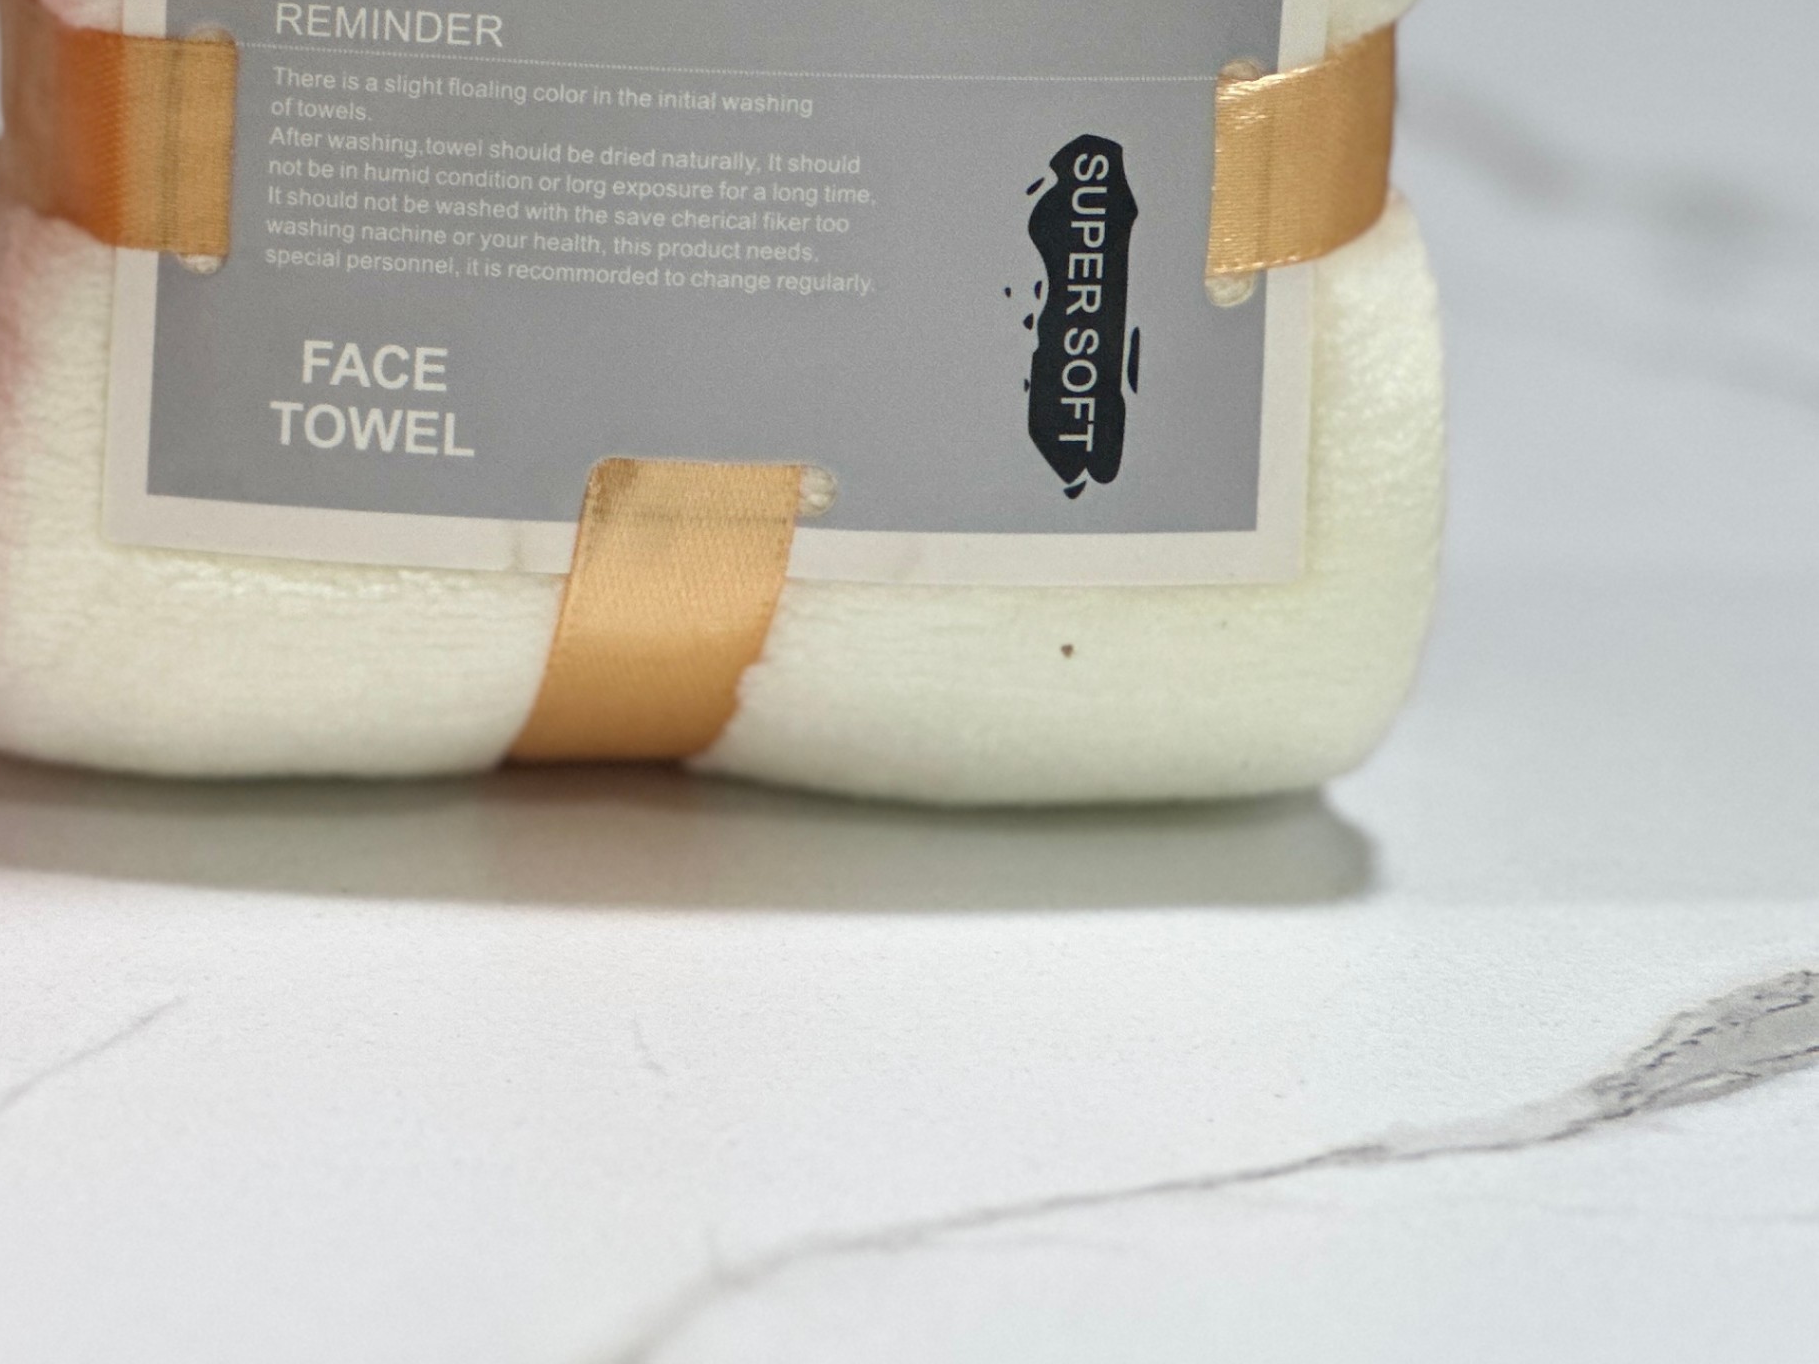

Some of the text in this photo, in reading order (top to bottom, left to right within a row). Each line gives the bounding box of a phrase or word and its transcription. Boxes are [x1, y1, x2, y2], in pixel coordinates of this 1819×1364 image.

[275, 1, 504, 48] REMINDER
[271, 97, 373, 121] of towels.
[273, 66, 336, 89] There
[342, 71, 360, 91] is
[365, 76, 379, 92] a
[384, 74, 443, 99] slight
[533, 83, 588, 104] color
[592, 87, 612, 105] in
[618, 87, 652, 108] the
[657, 89, 717, 110] initial
[721, 94, 813, 118] washing
[269, 126, 322, 148] After
[489, 139, 561, 164] should
[568, 144, 594, 164] be
[600, 146, 656, 167] dried
[768, 152, 782, 172] It
[787, 154, 861, 174] should
[268, 158, 303, 176] not
[308, 159, 334, 178] be
[339, 161, 358, 180] in
[364, 162, 430, 184] humid
[435, 171, 532, 190] condition
[538, 176, 561, 192] or
[613, 180, 714, 200] exposure
[719, 181, 749, 201] for
[753, 186, 766, 201] a
[772, 183, 818, 208] long
[268, 185, 282, 205] It
[287, 188, 358, 209] should
[364, 194, 398, 213] not
[404, 194, 430, 214] be
[435, 199, 519, 219] washed
[524, 202, 569, 222] with
[575, 205, 608, 224] the
[614, 210, 666, 227] save
[815, 214, 850, 233] too
[266, 218, 355, 244] washing
[452, 230, 475, 245] or
[480, 233, 528, 252] your
[533, 232, 607, 256] health,
[614, 236, 652, 256] this
[658, 240, 742, 261] product
[265, 248, 341, 268] special
[346, 253, 460, 278] personnel,
[466, 258, 479, 276] it
[485, 260, 502, 278] is
[665, 268, 685, 286] to
[690, 269, 771, 294] change
[777, 273, 876, 297] regularly.
[1059, 153, 1109, 452] SUPER SOFT
[302, 339, 449, 391] FACE
[269, 400, 475, 457] TOWEL
